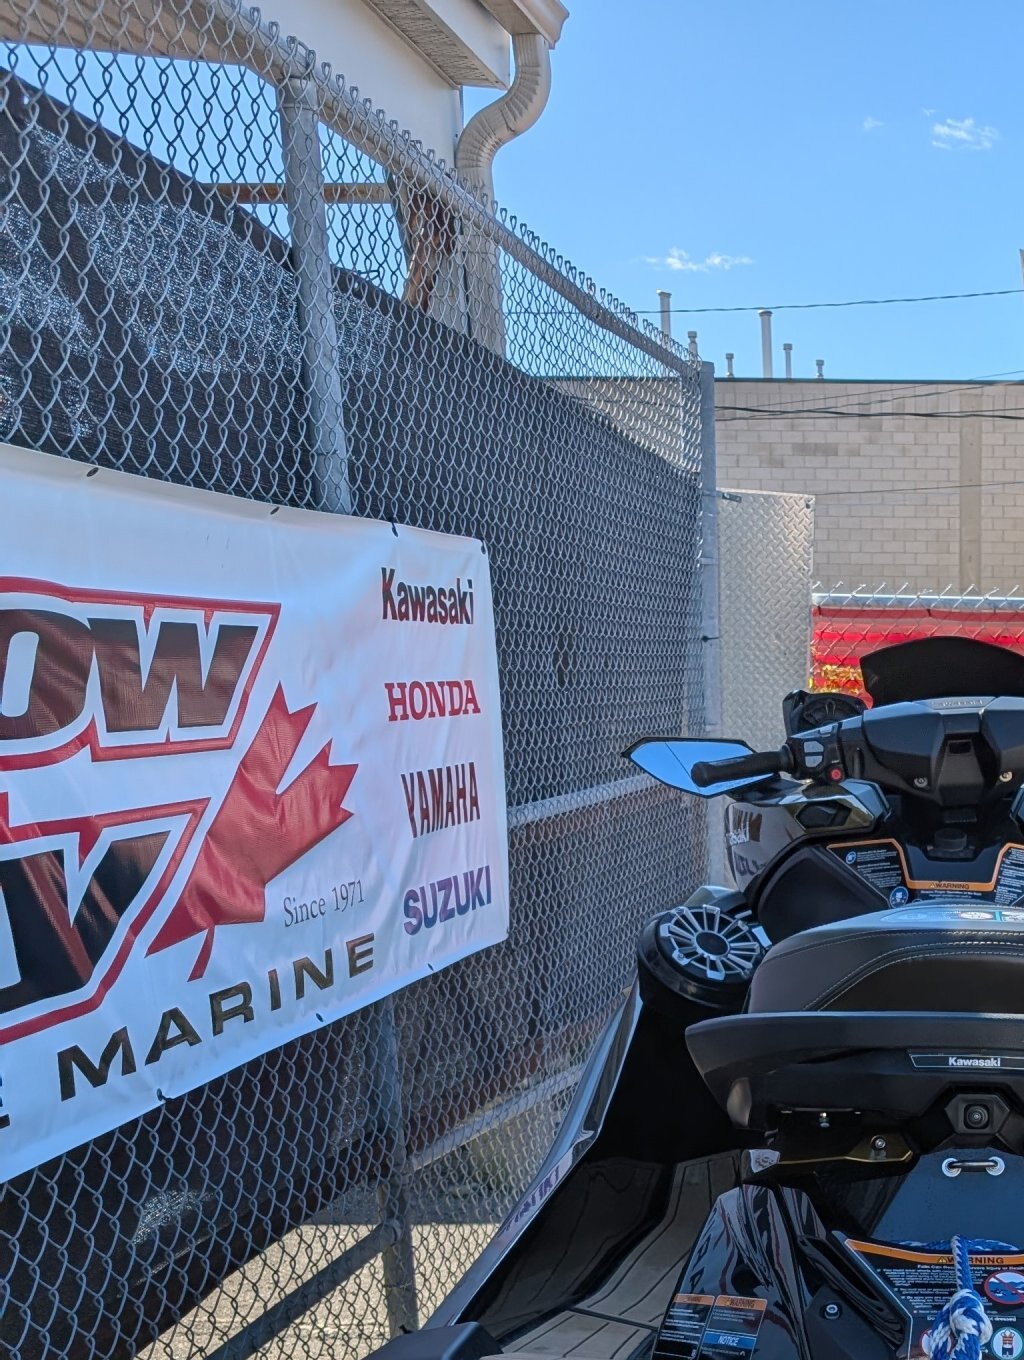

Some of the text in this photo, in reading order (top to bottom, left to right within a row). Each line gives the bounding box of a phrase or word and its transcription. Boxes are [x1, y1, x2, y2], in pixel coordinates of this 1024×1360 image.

[381, 567, 474, 625] Kawasaki
[384, 679, 481, 722] HONDA
[400, 761, 481, 838] YAMAHA
[283, 880, 365, 928] Since 1971
[403, 865, 492, 936] SUZUKI
[935, 882, 970, 890] WARNING
[57, 933, 375, 1102] MARINE
[948, 1056, 1001, 1067] Kawasaki
[947, 1256, 1005, 1265] WRNING
[718, 1335, 740, 1346] NOTICE
